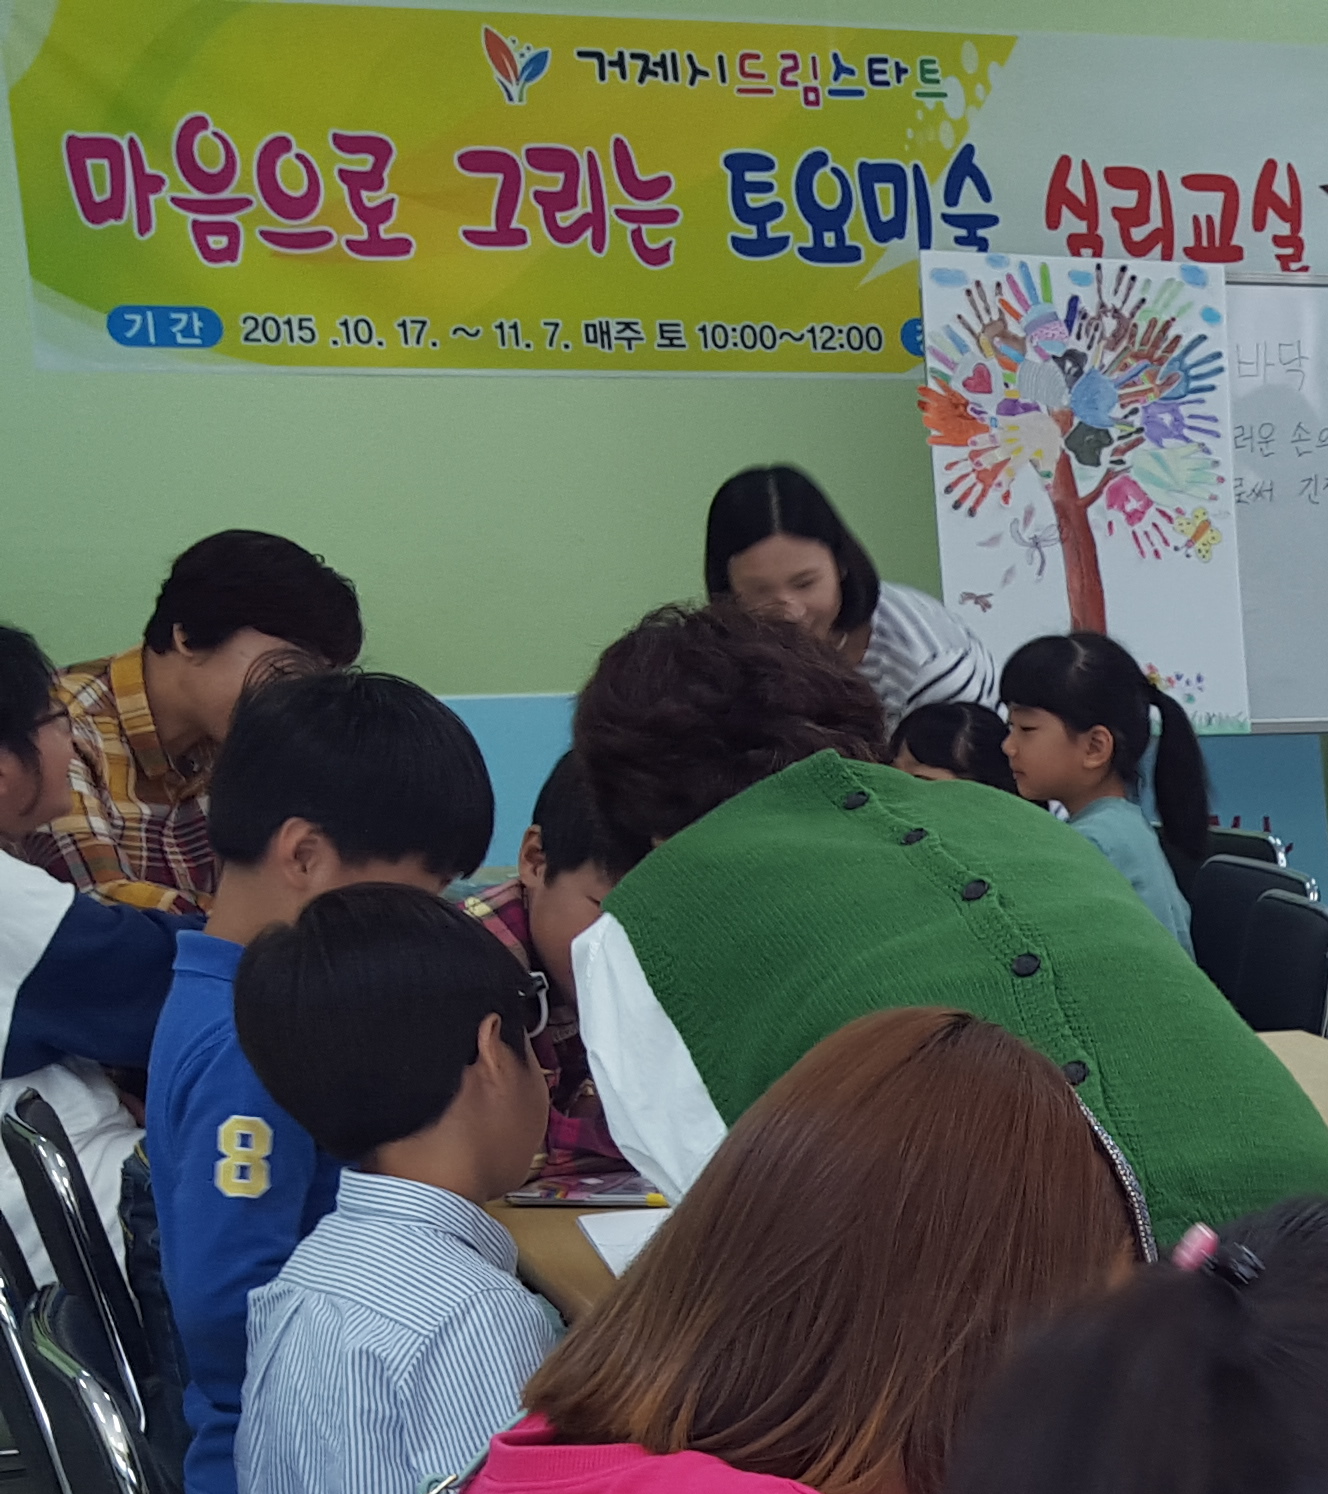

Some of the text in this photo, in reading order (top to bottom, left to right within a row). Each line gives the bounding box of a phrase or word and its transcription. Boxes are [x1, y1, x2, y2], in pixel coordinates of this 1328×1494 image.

[575, 49, 948, 108] 거제시드림스타트
[65, 114, 414, 265] 마음으로
[457, 135, 681, 267] 그리는
[1045, 154, 1311, 273] 심리교실
[241, 315, 316, 345] 2015
[397, 318, 439, 349] 17.
[493, 319, 533, 350] 11.
[542, 320, 573, 351] 7.
[583, 318, 646, 353] 매주
[655, 319, 688, 351] 토
[214, 1115, 273, 1198] 8
